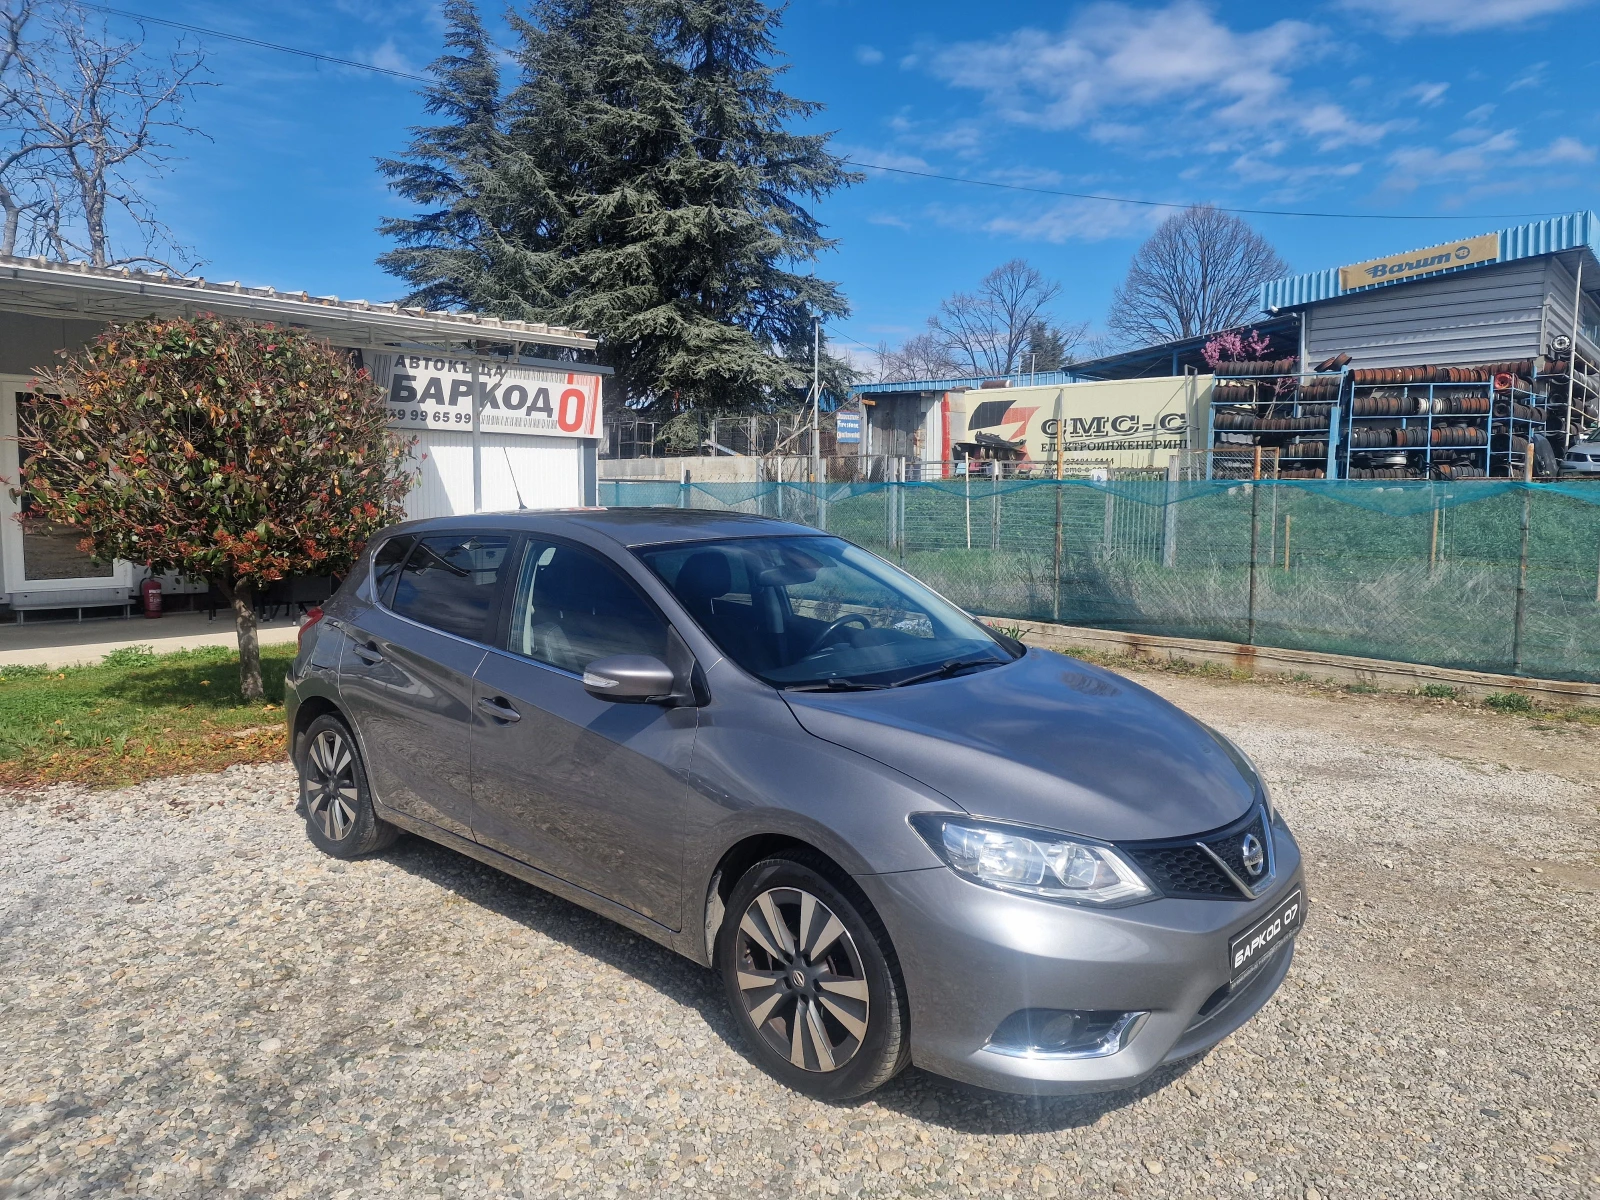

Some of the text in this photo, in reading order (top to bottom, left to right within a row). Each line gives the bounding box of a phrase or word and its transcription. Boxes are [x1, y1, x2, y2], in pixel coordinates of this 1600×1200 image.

[1364, 253, 1451, 278] Barum
[394, 355, 503, 378] АВТОКЪЩА
[390, 374, 553, 418] БАРКОД
[411, 410, 428, 421] 99
[433, 411, 450, 422] 65
[455, 412, 471, 424] 99
[1041, 440, 1191, 452] ЕЛКТРОИНЖЕНЕРИНГ
[1284, 903, 1298, 925] 07
